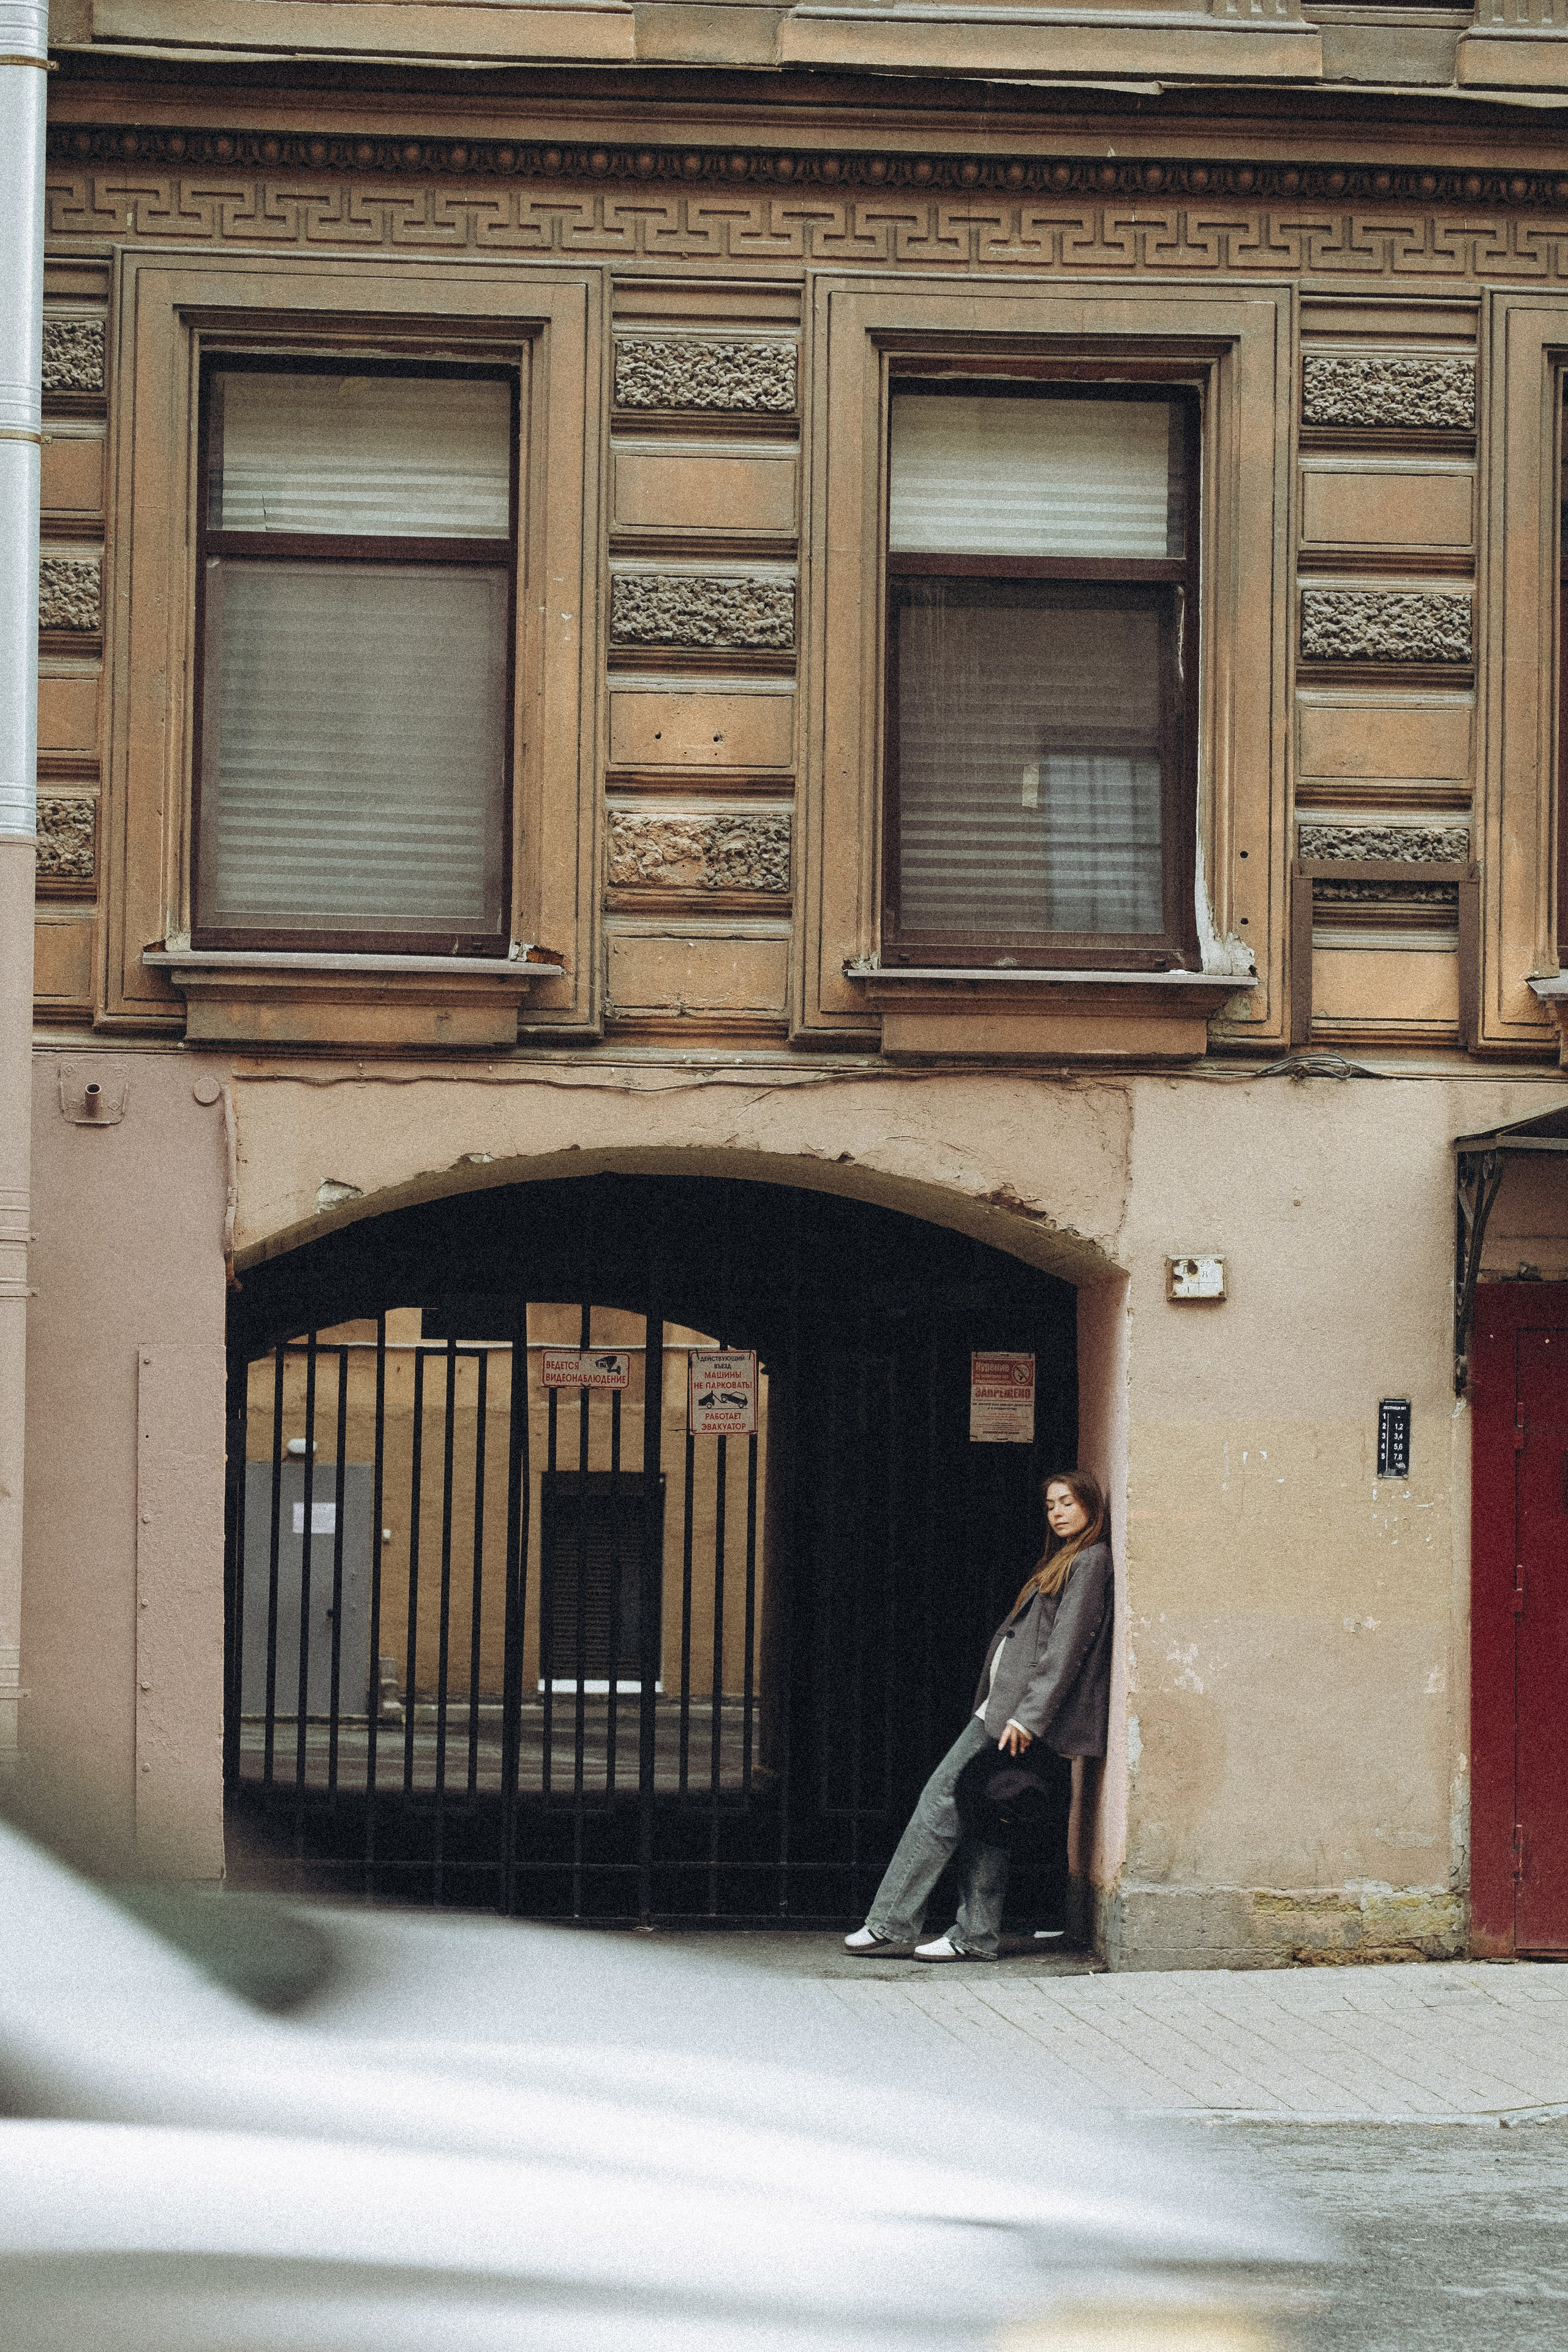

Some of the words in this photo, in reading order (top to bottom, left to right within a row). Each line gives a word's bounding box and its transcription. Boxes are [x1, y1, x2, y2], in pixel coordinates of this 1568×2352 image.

[546, 1360, 579, 1370] ВЕДЕТСЯ
[975, 1361, 1010, 1373] Курение
[545, 1373, 626, 1384] ВИДЕОНАБЛЮДЕНИЕ
[975, 1387, 1031, 1399] ЗАПРЕЩЕНО
